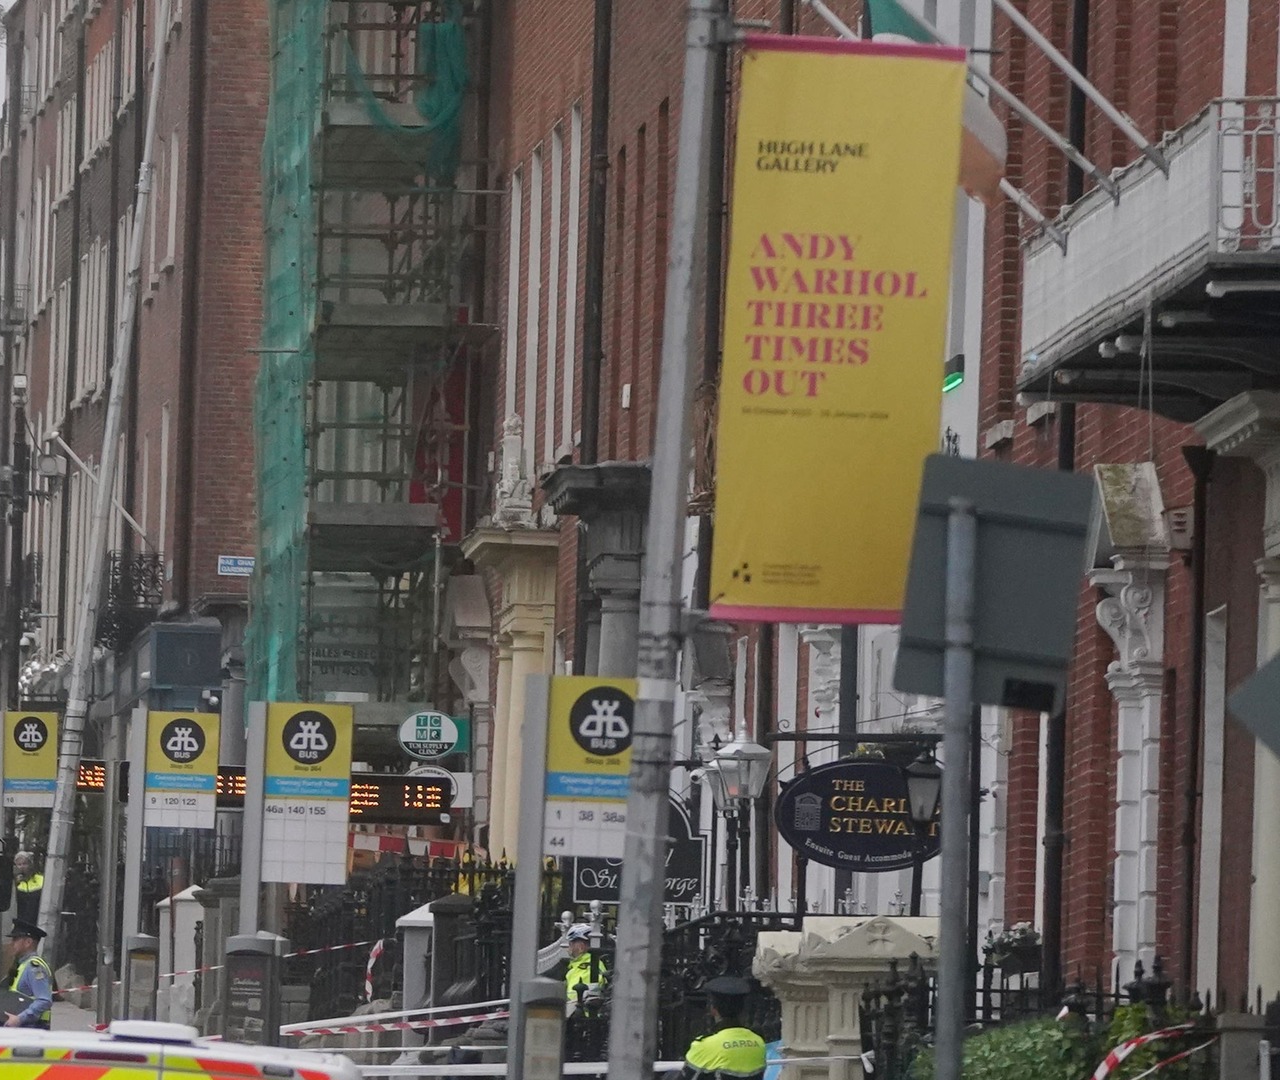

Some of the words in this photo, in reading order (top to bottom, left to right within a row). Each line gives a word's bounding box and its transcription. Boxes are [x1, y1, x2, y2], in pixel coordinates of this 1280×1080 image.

[757, 139, 814, 156] HUGH
[819, 142, 868, 158] LANE
[756, 156, 839, 173] GALLERY
[750, 232, 863, 261] ANDY
[749, 265, 929, 299] WARHOL
[746, 301, 885, 331] THREE
[744, 334, 870, 366] TIMES
[742, 369, 827, 397] OUT
[590, 737, 616, 749] BUS
[174, 751, 191, 759] BUS
[298, 751, 318, 759] BUS
[831, 779, 865, 791] THE
[150, 797, 157, 805] 9
[164, 797, 180, 805] 120
[830, 795, 941, 815] CHARL
[265, 806, 284, 814] 46a
[287, 806, 305, 814] 140
[308, 807, 326, 815] 155
[578, 810, 594, 822] 38
[829, 817, 941, 837] STEWAT
[549, 837, 565, 847] 44
[805, 837, 835, 857] Ensuite
[837, 850, 862, 862] Guest
[864, 849, 920, 862] Accommoda
[722, 1040, 760, 1050] GARDA
